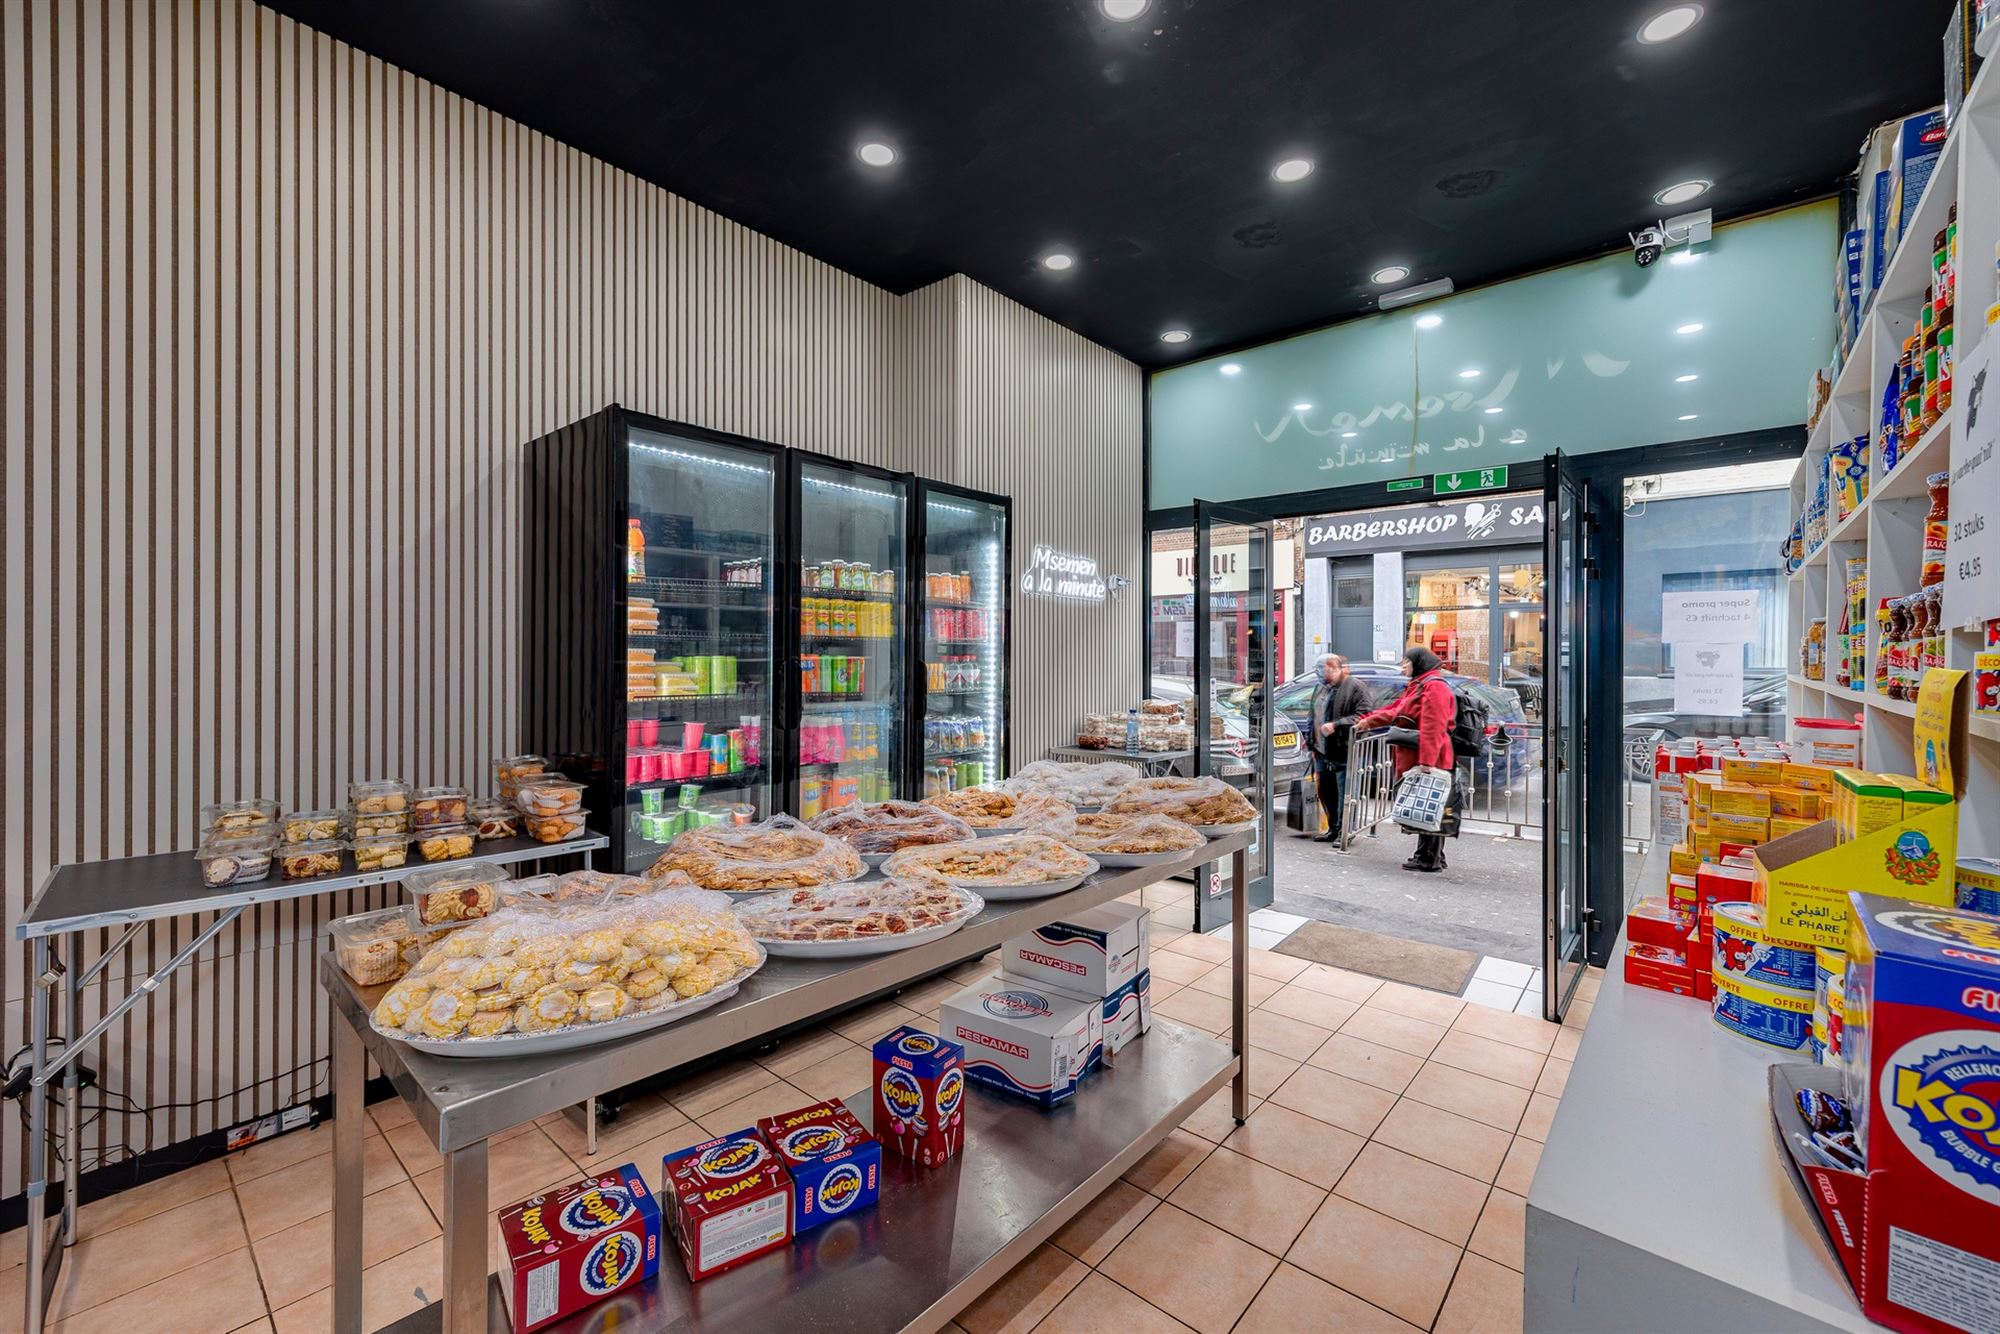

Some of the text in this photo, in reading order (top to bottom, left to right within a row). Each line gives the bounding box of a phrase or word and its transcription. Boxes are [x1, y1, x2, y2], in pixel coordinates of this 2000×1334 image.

[1308, 514, 1458, 546] BARBERSHOP
[1954, 513, 1985, 543] 32 stuks
[1035, 547, 1097, 577] Msemen
[1959, 556, 1982, 581] €4.95
[1039, 569, 1053, 592] la
[1057, 575, 1106, 599] minute
[1778, 881, 1810, 890] HARISSA
[1729, 924, 1759, 940] OFFRE
[1779, 916, 1841, 934] LE PHARE
[1812, 933, 1826, 942] 12
[1019, 949, 1087, 976] PESCAMAR
[1773, 997, 1809, 1011] OFFRE
[902, 1038, 934, 1052] KOJAK
[957, 1027, 1029, 1059] PESCAMAR
[891, 1056, 913, 1071] FIESTA
[883, 1080, 921, 1107] KOJAK
[938, 1078, 962, 1105] KOJAK
[784, 1107, 833, 1128] KOJAK
[695, 1137, 727, 1152] FIESTA
[790, 1130, 843, 1157] KOJAK
[822, 1150, 853, 1164] FIESTA
[1939, 1129, 1990, 1170] BUBBLE
[702, 1141, 759, 1174] KOJAK
[628, 1178, 647, 1198] FIESTA
[703, 1172, 763, 1203] KOJAK
[819, 1176, 860, 1202] KOJAK
[867, 1163, 877, 1190] FIESTA
[1815, 1172, 1839, 1206] FIESTA
[581, 1189, 624, 1227] KOJAK
[804, 1186, 814, 1215] FIESTA
[520, 1206, 551, 1245] KOJAK
[602, 1233, 624, 1290] KOJAK
[647, 1234, 658, 1262] FIESTA
